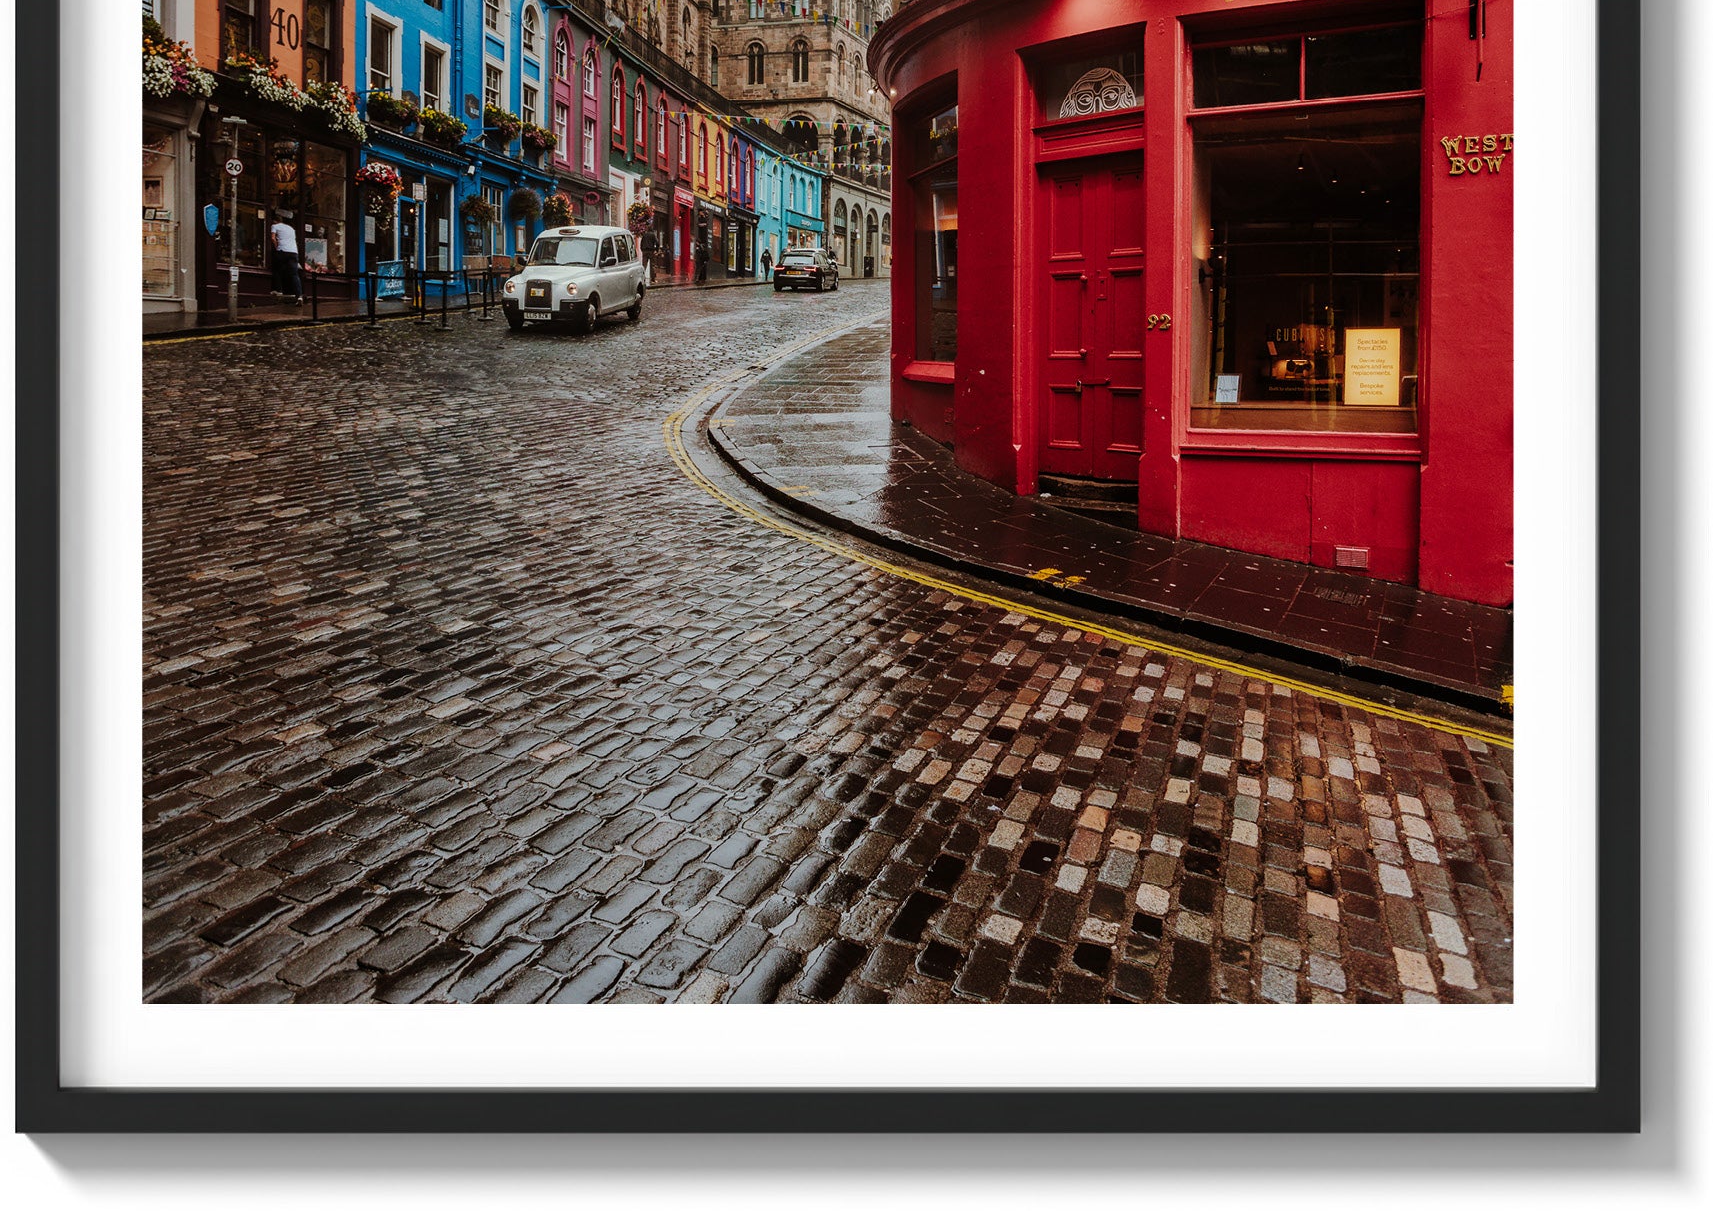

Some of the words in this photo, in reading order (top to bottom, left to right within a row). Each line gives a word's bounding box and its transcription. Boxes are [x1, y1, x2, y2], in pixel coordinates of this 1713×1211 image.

[270, 7, 299, 51] 40
[1441, 134, 1514, 157] WEST
[227, 162, 241, 172] 20
[1448, 154, 1506, 175] BOW
[1147, 314, 1171, 330] 92
